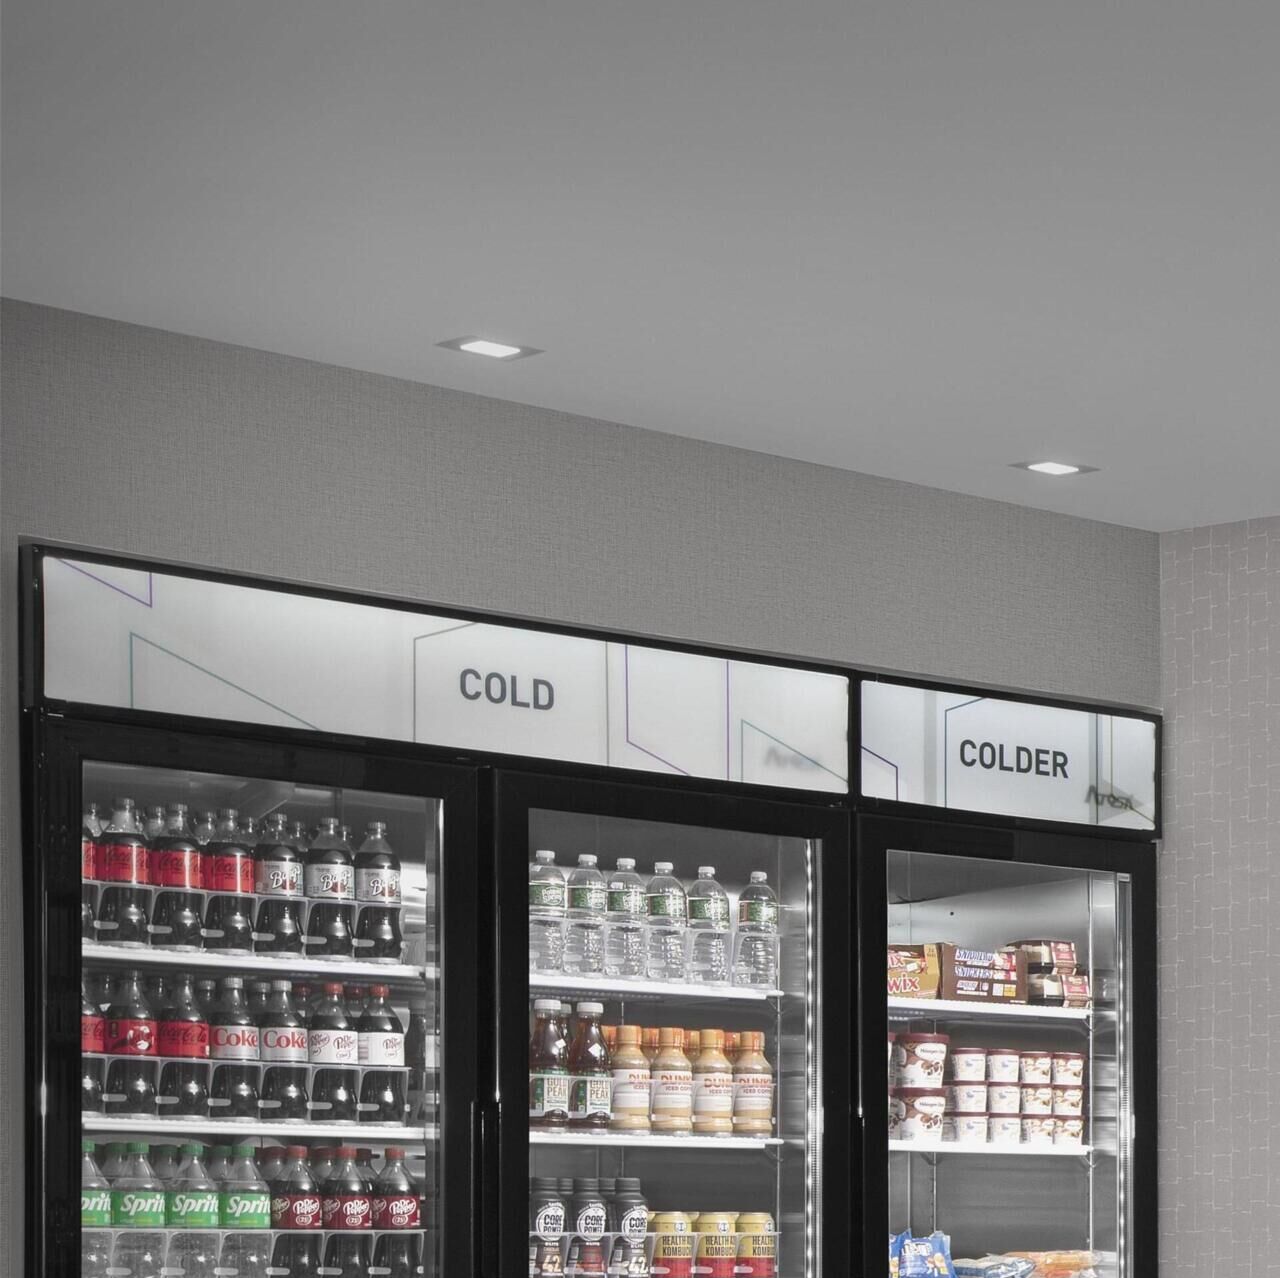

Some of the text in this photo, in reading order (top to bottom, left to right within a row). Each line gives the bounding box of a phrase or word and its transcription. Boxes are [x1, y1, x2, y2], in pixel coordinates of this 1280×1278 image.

[459, 668, 556, 711] COLD
[959, 740, 1069, 778] COLDER
[888, 974, 920, 992] wix
[213, 1028, 258, 1047] Coke
[264, 1029, 307, 1048] Coke
[547, 1087, 566, 1096] PEAK
[82, 1197, 111, 1215] prit
[294, 1201, 319, 1214] Pepper
[344, 1201, 369, 1215] Pepper
[390, 1201, 416, 1215] Pepper
[544, 1215, 562, 1225] CORE
[585, 1215, 603, 1225] CORE
[629, 1217, 647, 1228] CORE
[663, 1247, 691, 1256] KOMBUC
[706, 1247, 735, 1257] KOMBUC
[542, 1255, 560, 1273] 42
[631, 1255, 648, 1274] 42
